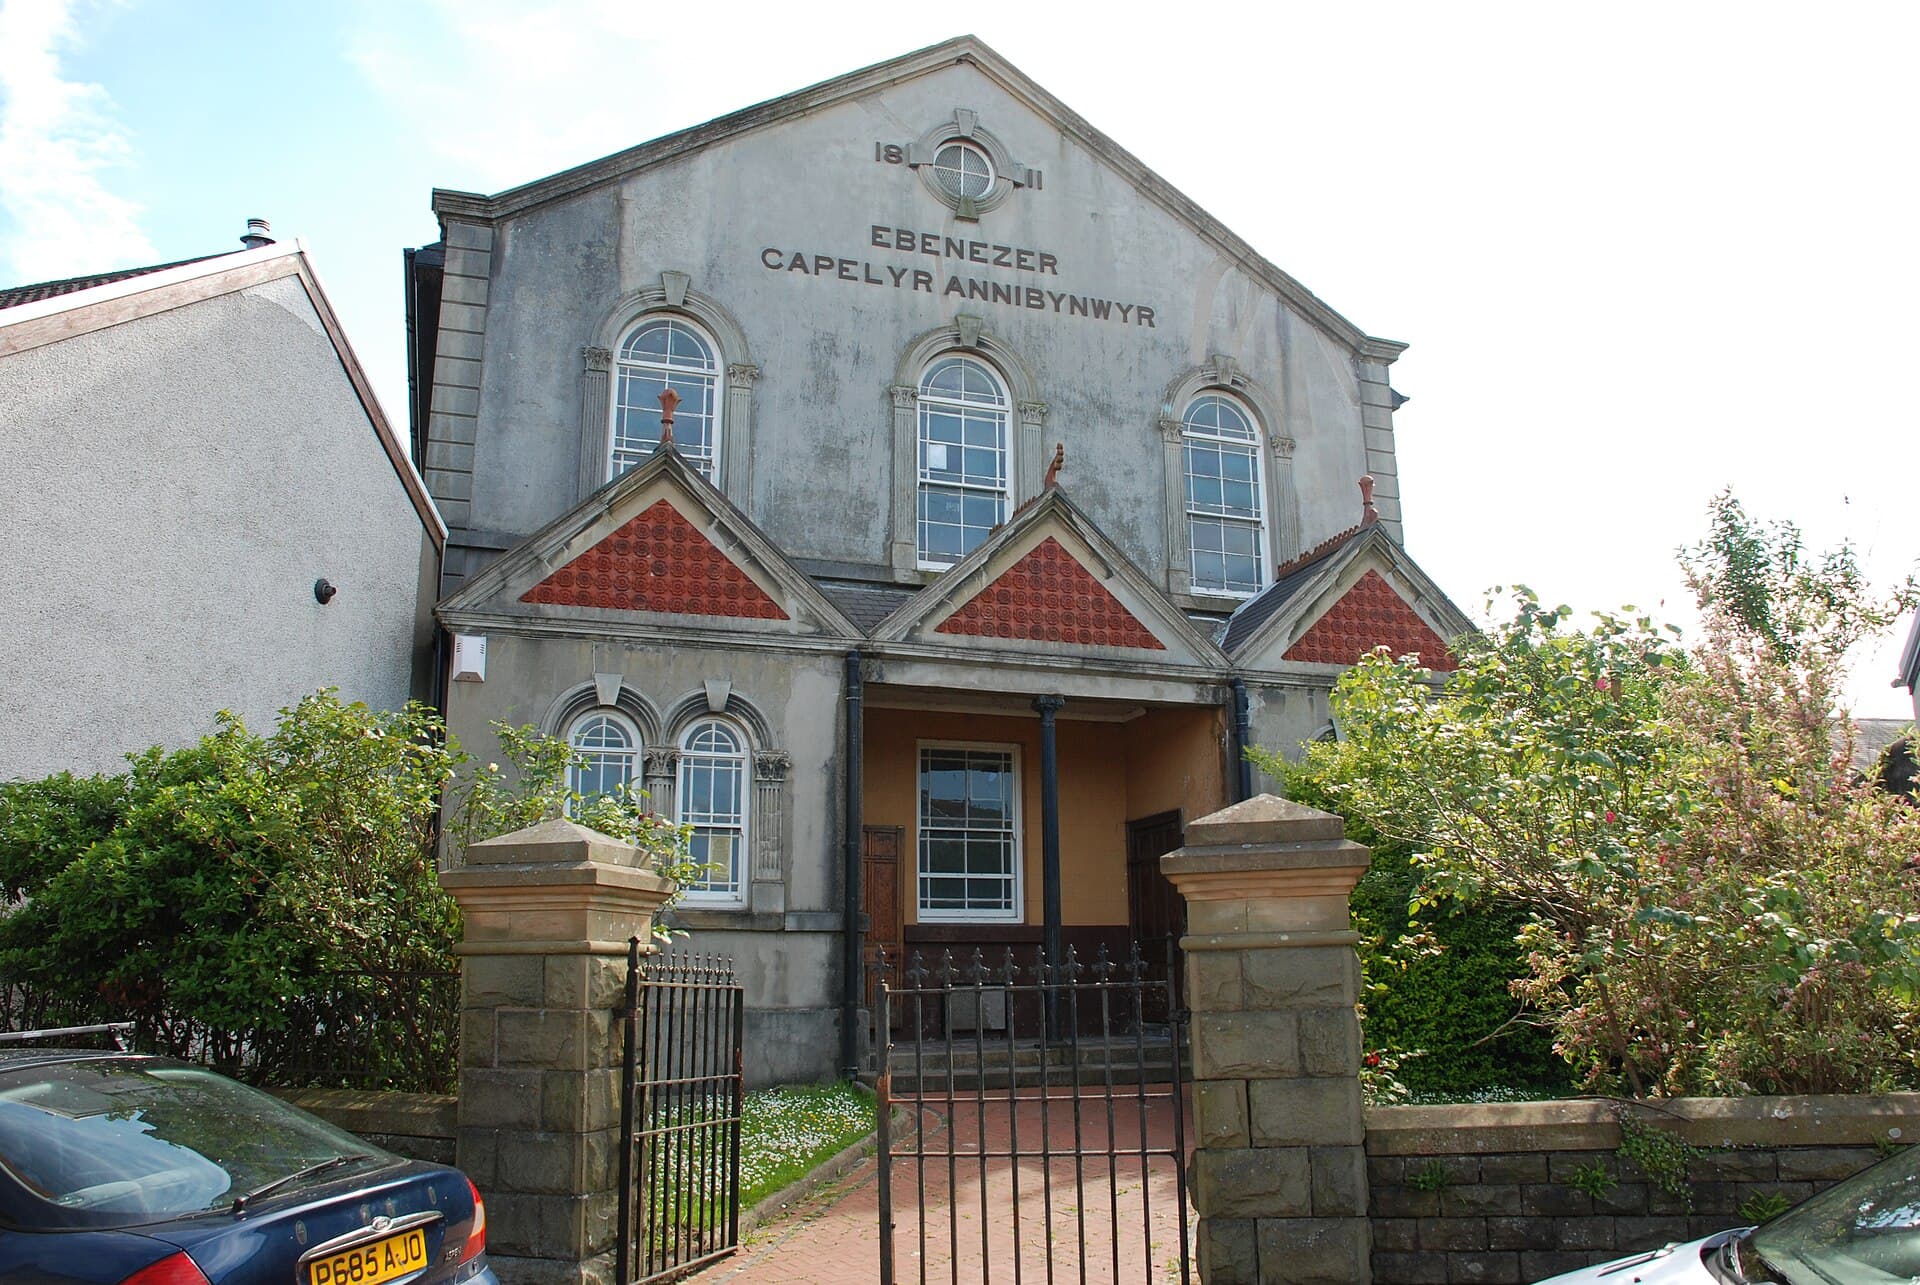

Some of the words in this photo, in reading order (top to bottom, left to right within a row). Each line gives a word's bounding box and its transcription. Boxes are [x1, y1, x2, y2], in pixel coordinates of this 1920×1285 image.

[876, 141, 903, 164] 18
[1027, 169, 1043, 190] 11
[872, 225, 1058, 275] EBENEZER
[944, 275, 1156, 328] ANNIBYNWYR
[316, 1247, 378, 1285] P685
[385, 1234, 421, 1271] AJO
